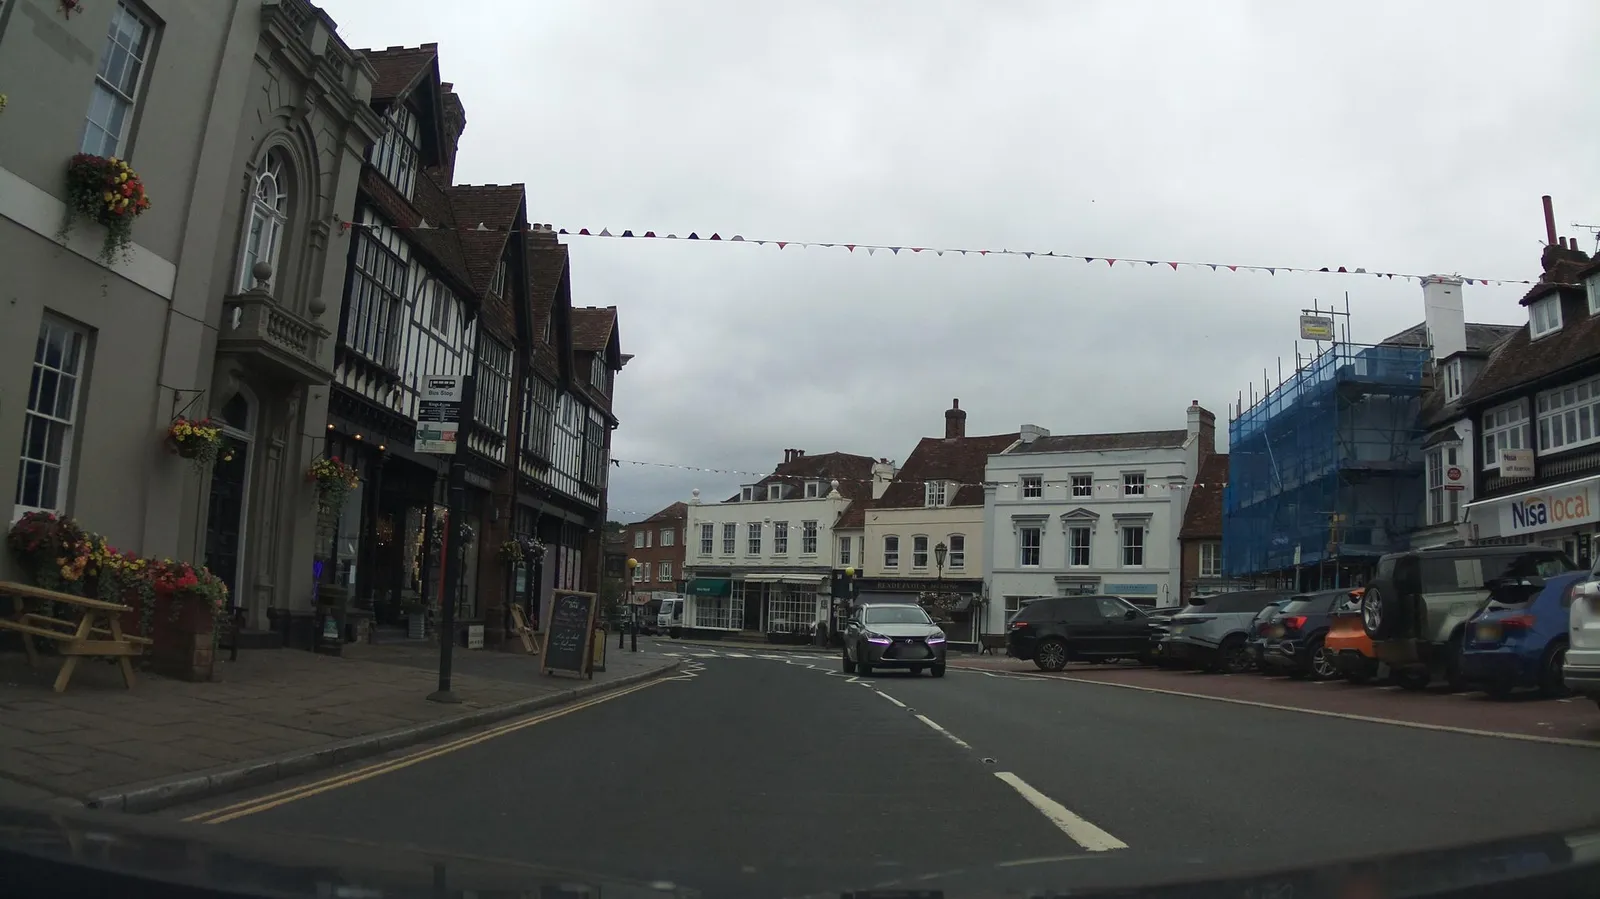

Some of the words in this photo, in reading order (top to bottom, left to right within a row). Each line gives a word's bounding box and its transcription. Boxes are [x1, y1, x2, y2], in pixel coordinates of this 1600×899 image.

[1511, 498, 1547, 529] Nisa
[1549, 487, 1590, 523] local
[877, 582, 926, 590] RENDEZVOUS
